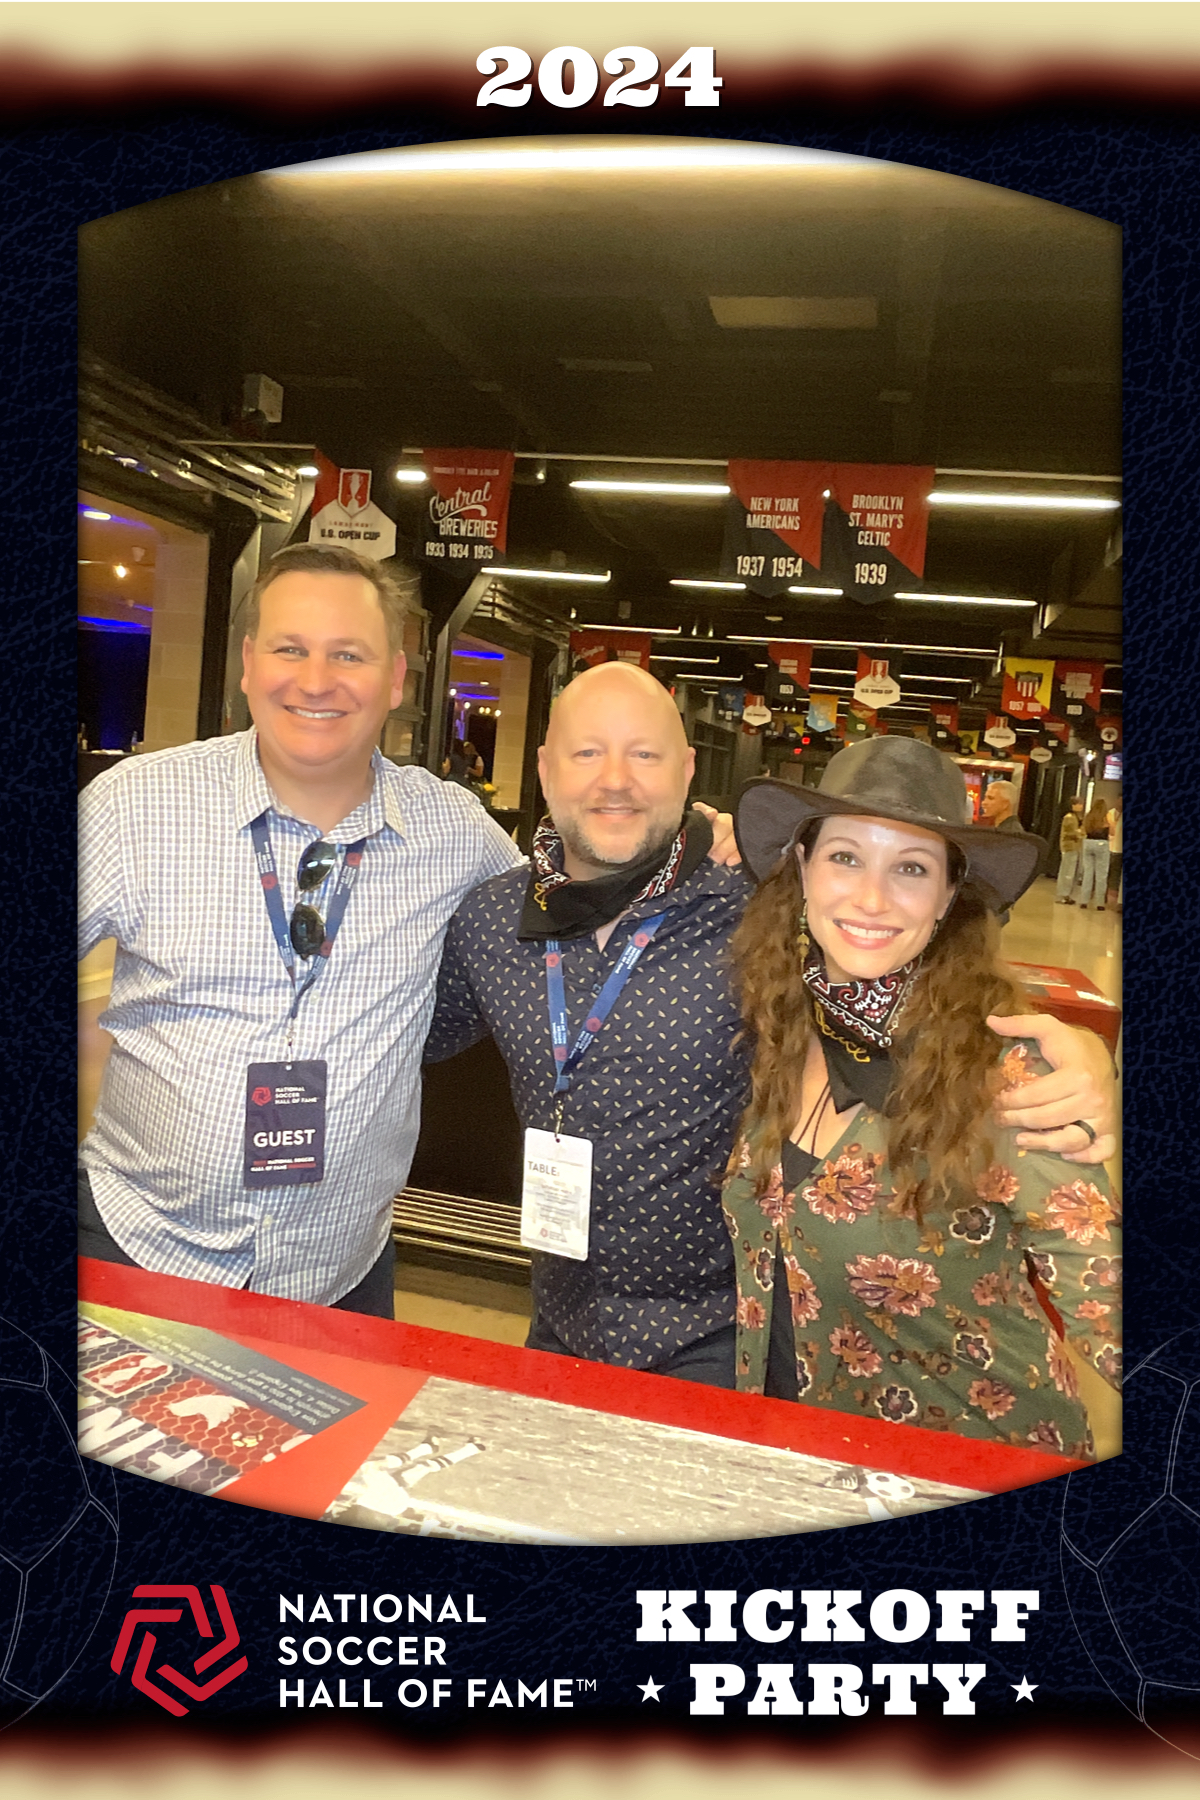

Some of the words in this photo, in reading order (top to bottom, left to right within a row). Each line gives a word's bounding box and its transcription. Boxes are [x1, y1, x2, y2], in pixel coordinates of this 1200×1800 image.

[429, 481, 492, 524] Central
[750, 496, 772, 512] NEW
[774, 497, 799, 513] YORK
[852, 494, 904, 511] BROOKLYN
[439, 518, 498, 538] BREWERIES
[746, 513, 801, 531] AMERICANS
[848, 511, 864, 528] ST.
[865, 512, 905, 529] MARY'S
[338, 530, 361, 541] OPEN
[363, 531, 381, 541] CUP
[857, 530, 891, 547] CELTIC
[425, 541, 446, 557] 1933
[448, 542, 469, 559] 1934
[736, 555, 765, 577] 1937
[771, 557, 803, 578] 1954
[854, 562, 888, 585] 1939
[253, 1128, 316, 1148] GUEST
[77, 1396, 204, 1483] FIN
